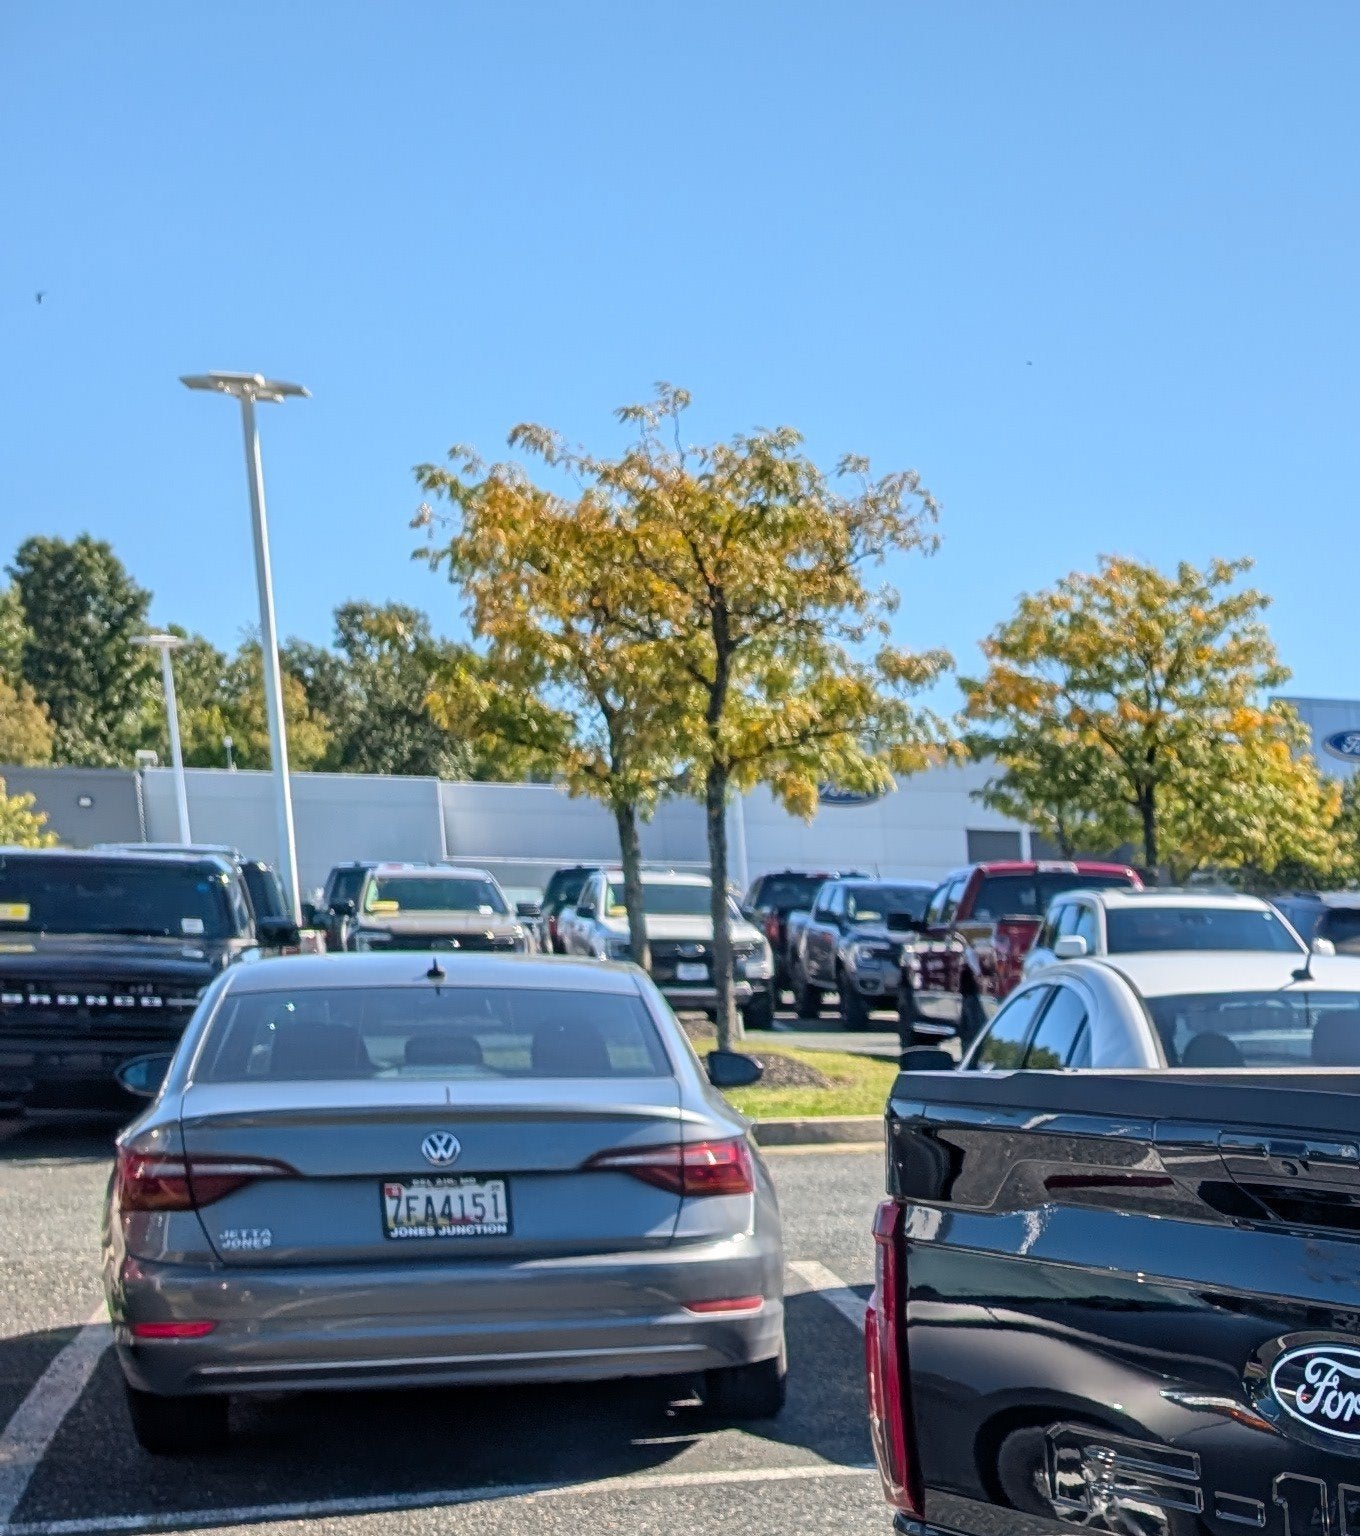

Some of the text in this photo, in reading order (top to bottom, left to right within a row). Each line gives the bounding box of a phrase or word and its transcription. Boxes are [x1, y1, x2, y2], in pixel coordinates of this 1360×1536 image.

[0, 993, 164, 1007] BRONCO
[390, 1223, 508, 1238] JONES JUNCTION
